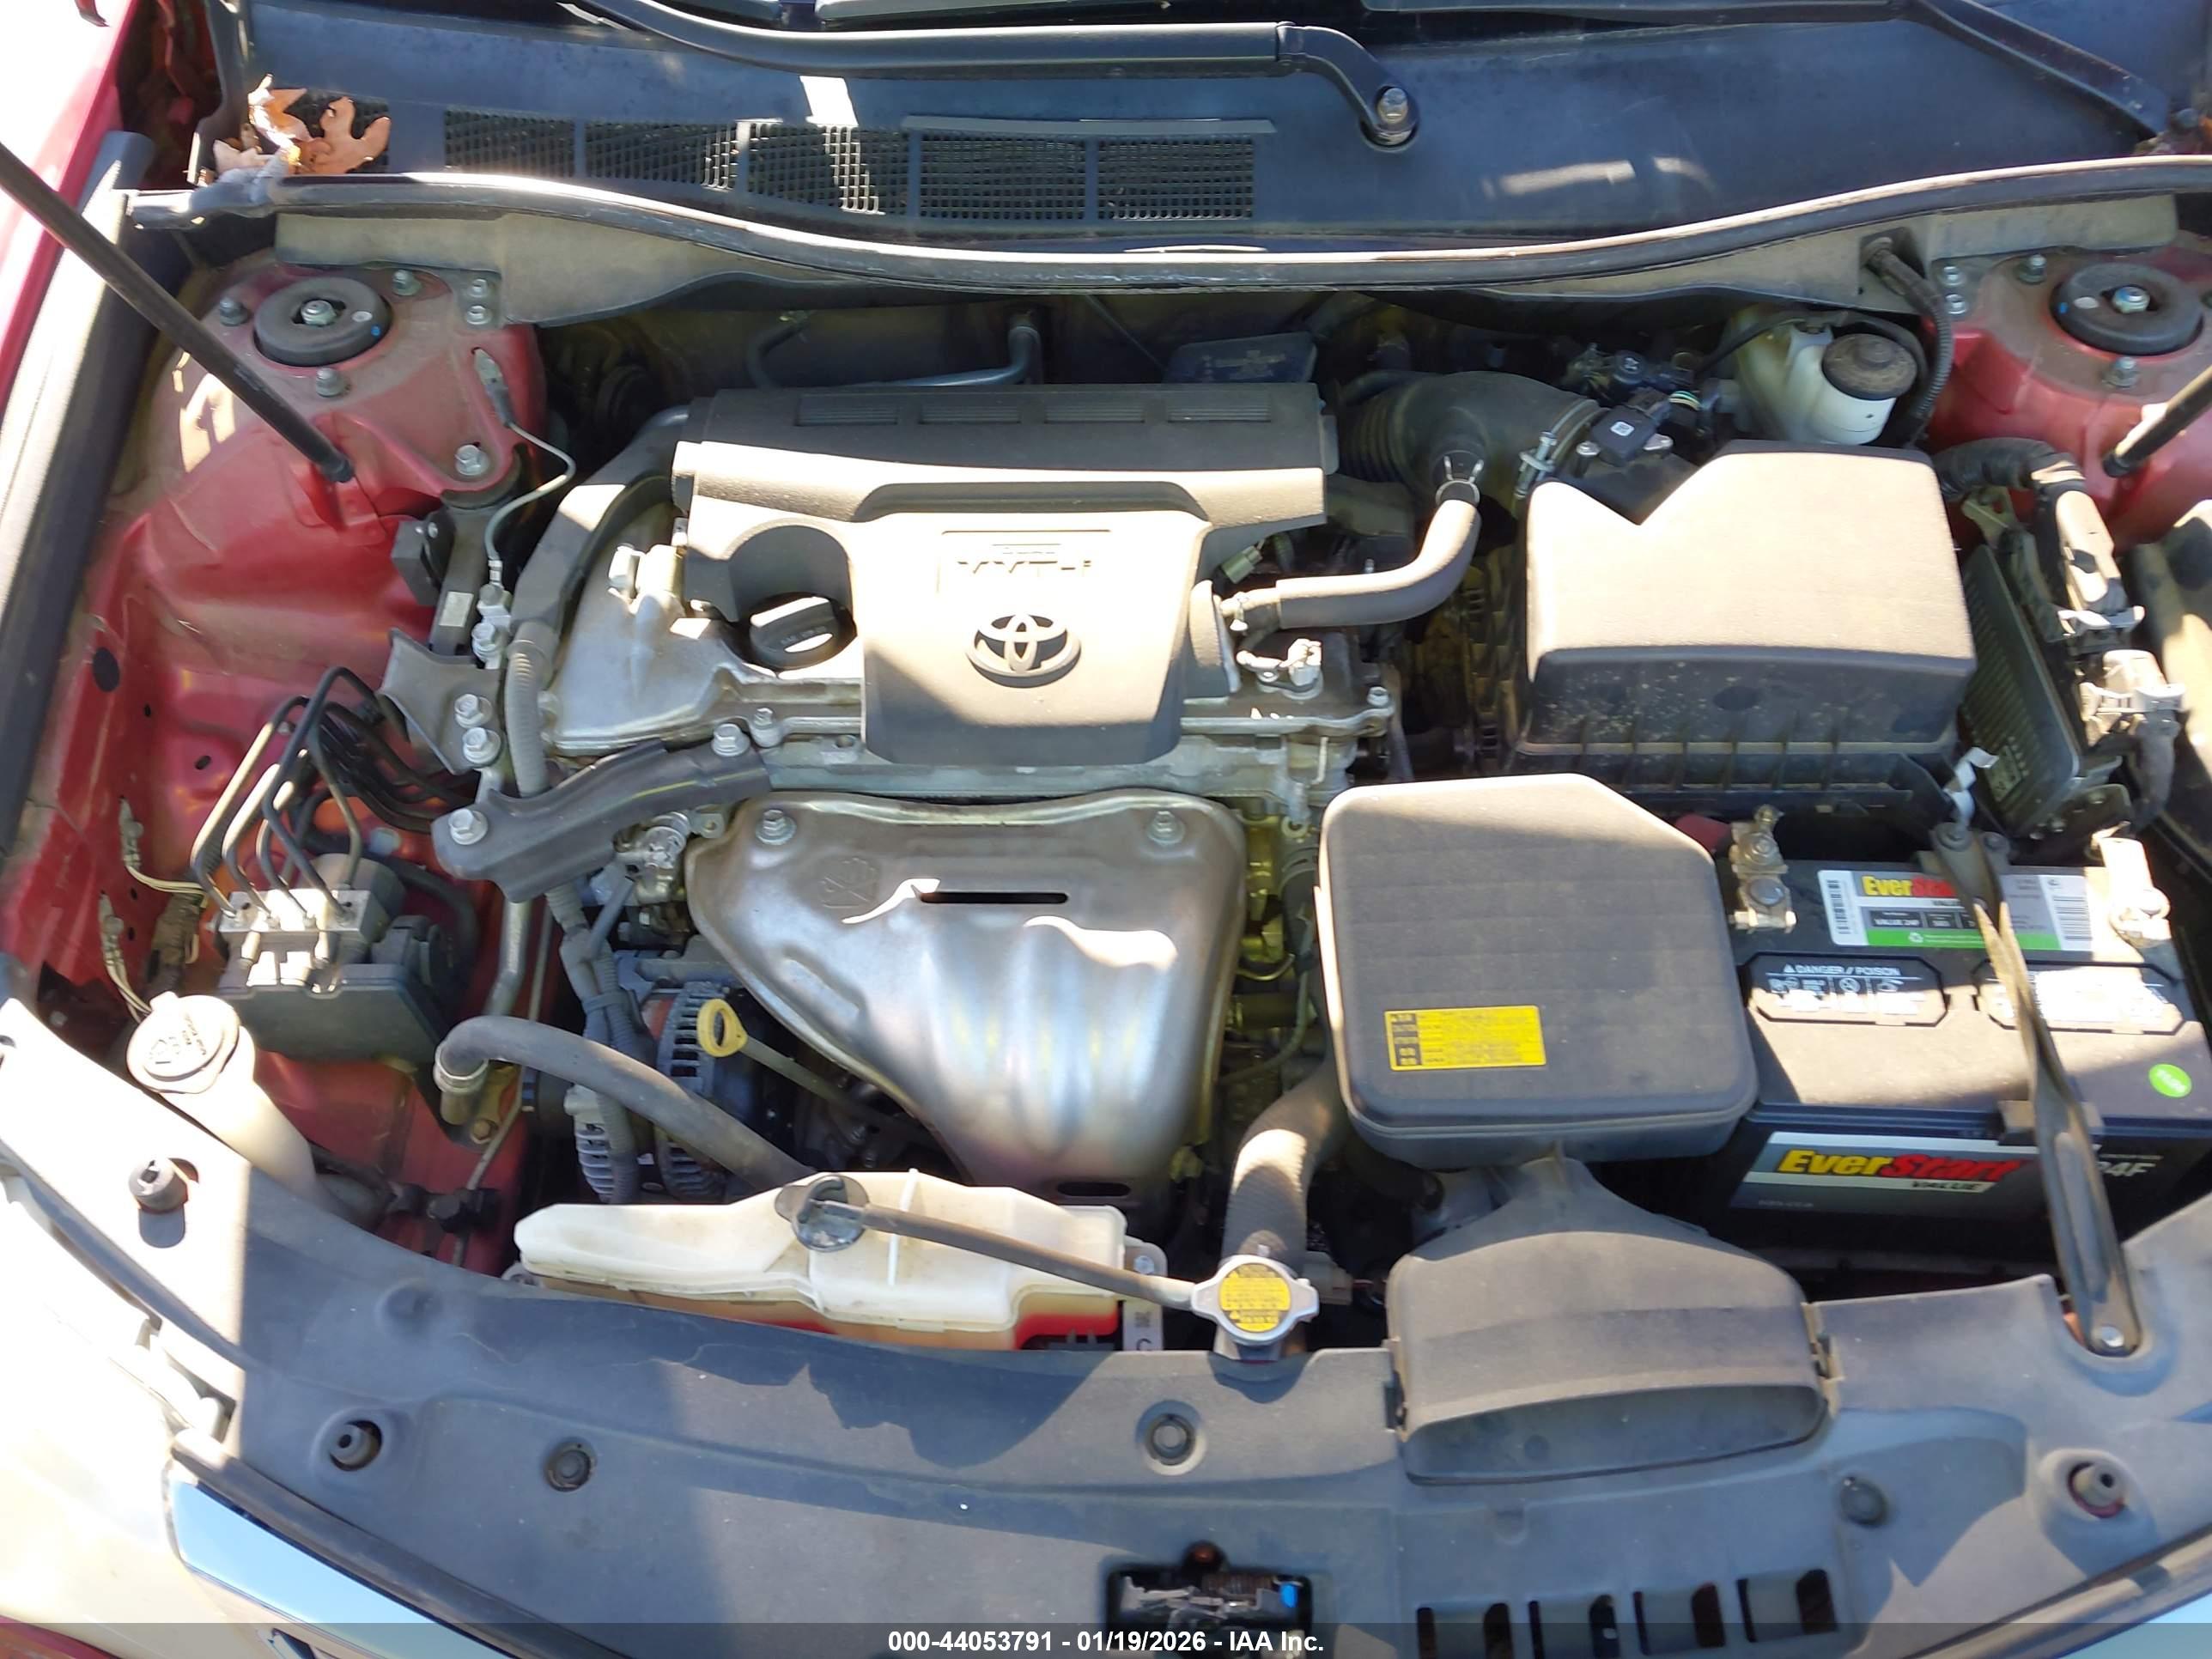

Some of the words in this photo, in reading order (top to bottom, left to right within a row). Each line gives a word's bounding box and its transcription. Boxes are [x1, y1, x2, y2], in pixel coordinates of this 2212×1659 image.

[1795, 964, 1845, 975] DANGER
[1855, 966, 1901, 976] POISON
[1778, 1148, 2021, 1183] EverStart
